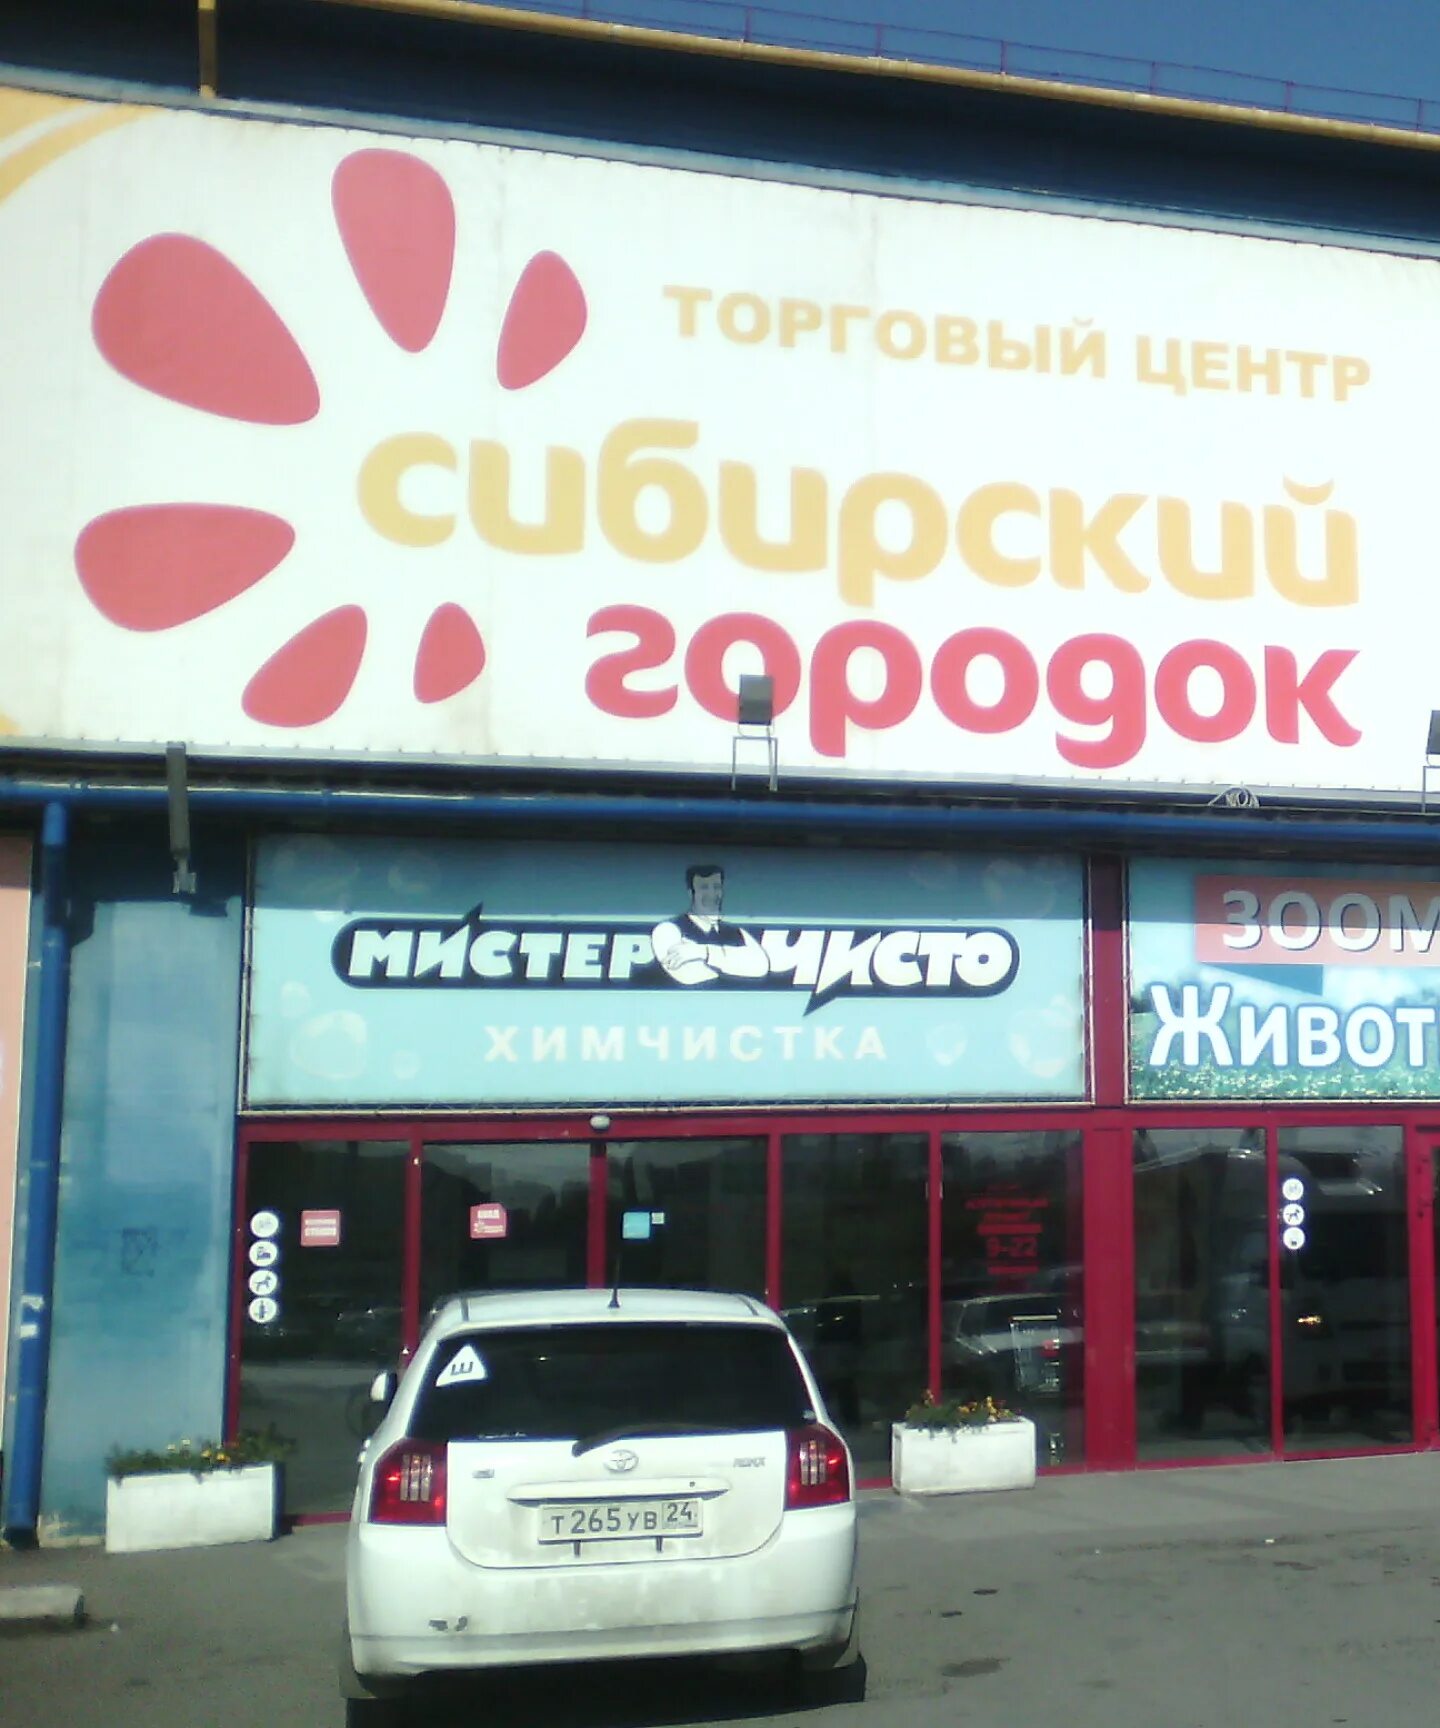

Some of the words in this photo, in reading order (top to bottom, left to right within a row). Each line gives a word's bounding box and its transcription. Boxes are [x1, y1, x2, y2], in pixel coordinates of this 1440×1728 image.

[662, 284, 1107, 379] ТОРГОВЫЙ
[1135, 334, 1371, 402] ЦЕНТР
[356, 416, 1360, 608] сибирский
[585, 602, 1363, 769] городок
[348, 922, 655, 979] МИСТЕР
[760, 928, 1013, 995] ЧИСТО
[483, 1024, 888, 1063] ХИМЧИСТКА
[450, 1361, 474, 1377] Ш
